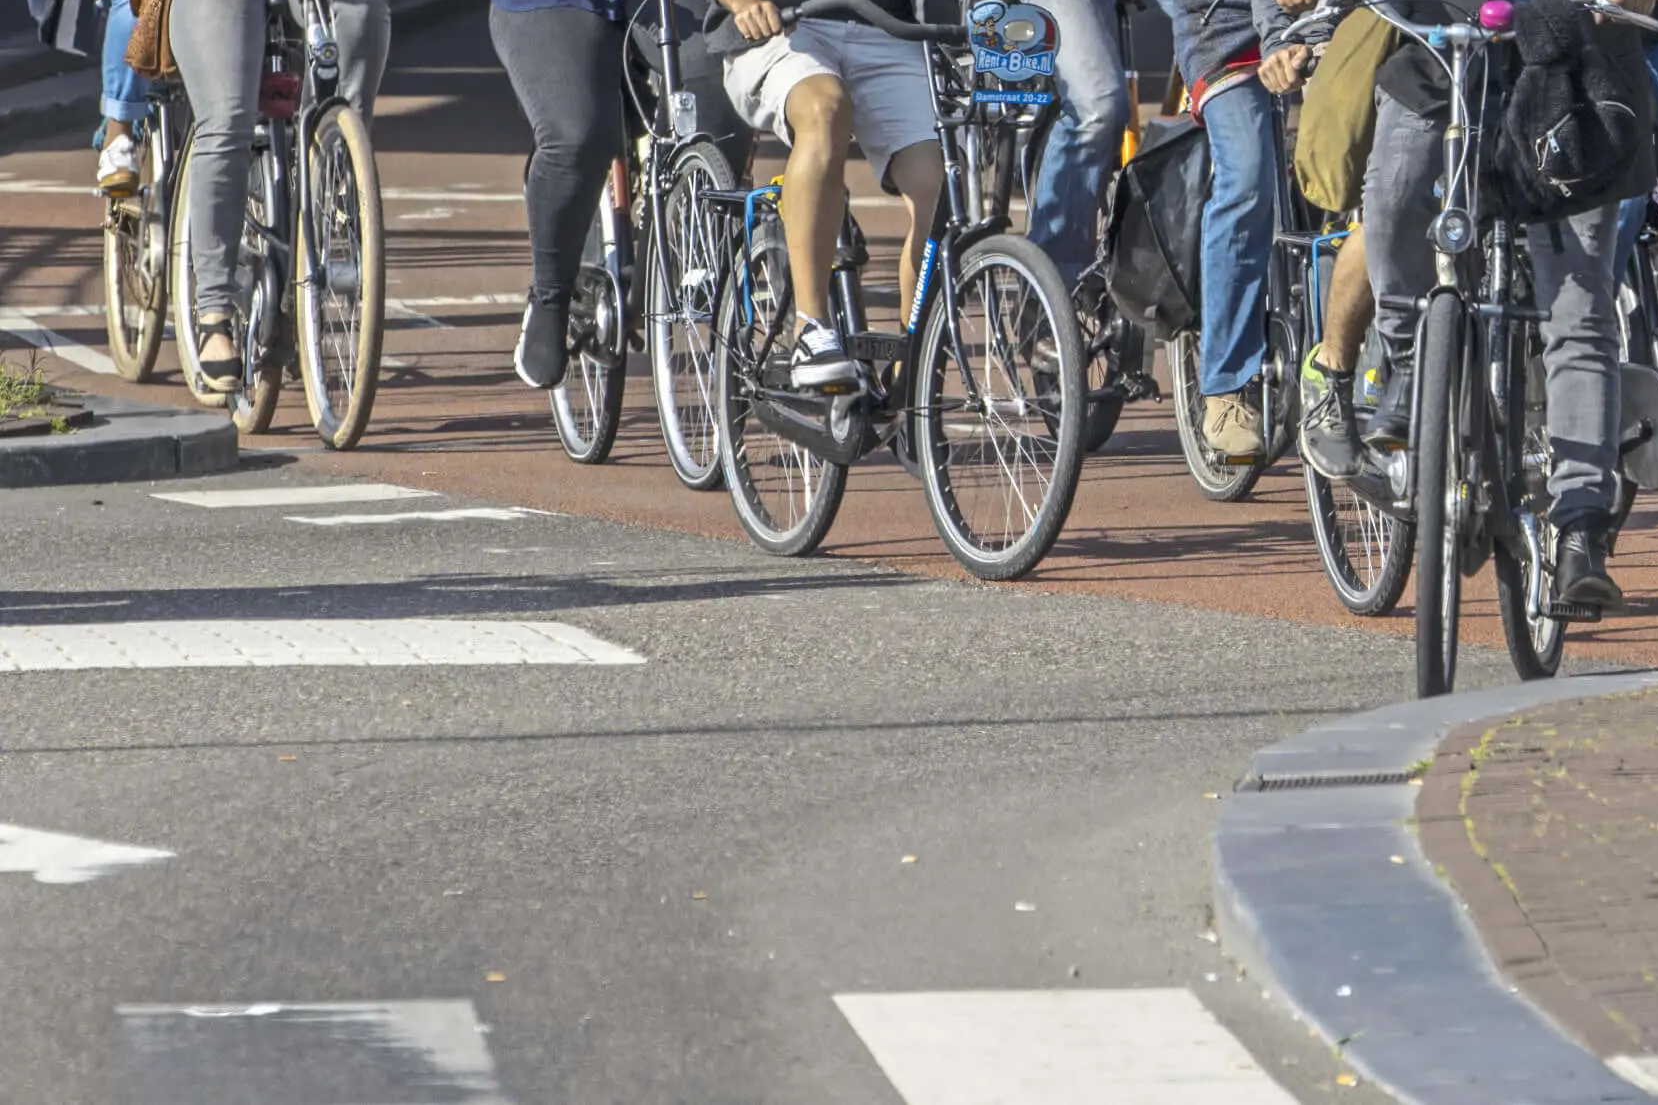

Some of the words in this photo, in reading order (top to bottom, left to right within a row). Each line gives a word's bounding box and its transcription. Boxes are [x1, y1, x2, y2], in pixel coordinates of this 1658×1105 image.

[978, 50, 1000, 69] Rent
[1008, 52, 1051, 73] Bike.nl
[975, 93, 1021, 102] Damstraat
[1022, 94, 1048, 103] 20-22
[908, 241, 934, 329] rentabike.nl
